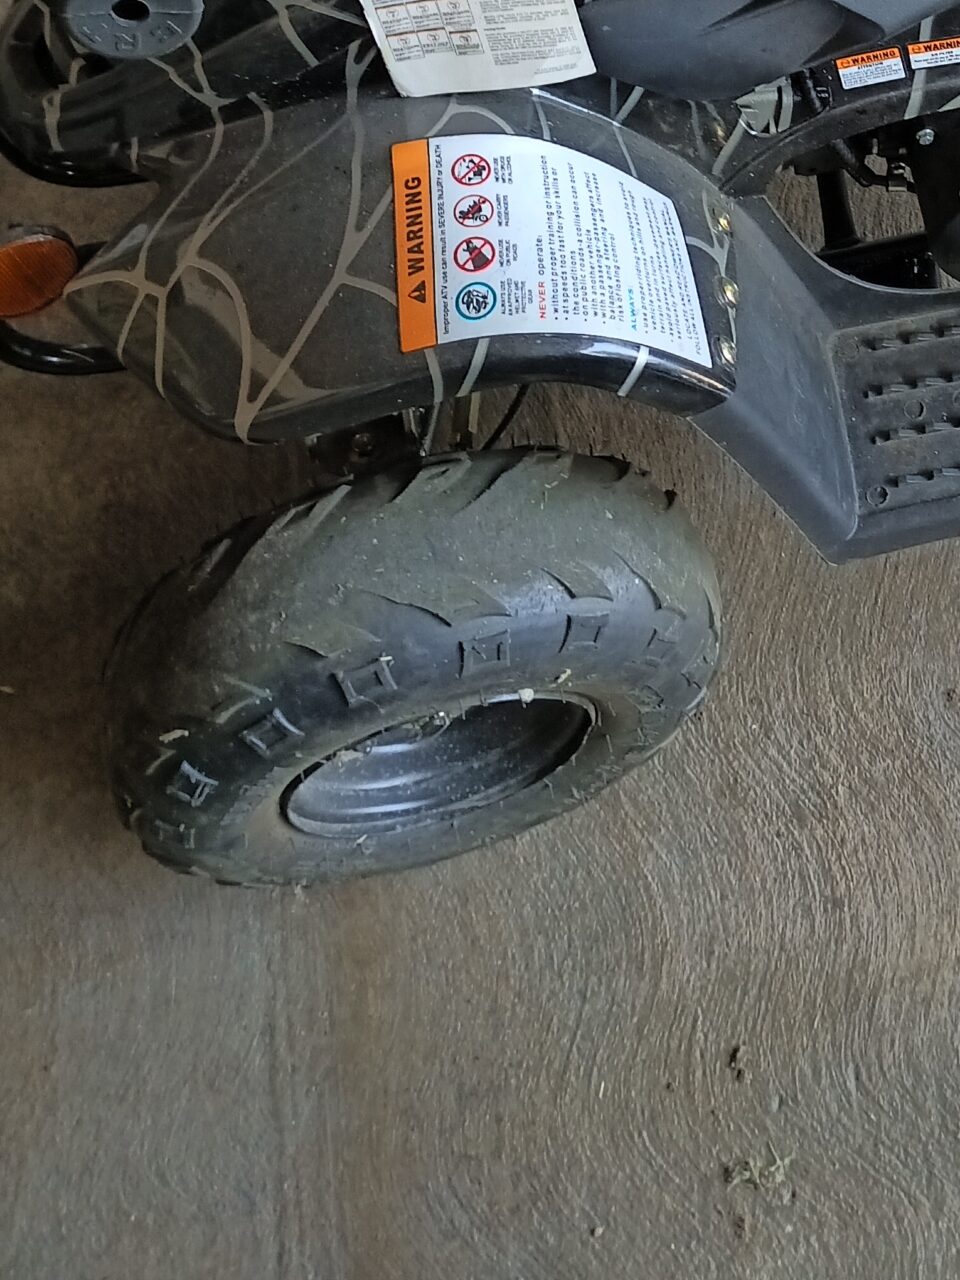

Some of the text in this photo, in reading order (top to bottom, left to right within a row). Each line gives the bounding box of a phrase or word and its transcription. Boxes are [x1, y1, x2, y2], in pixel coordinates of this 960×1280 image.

[850, 50, 896, 65] WARNING
[434, 144, 442, 168] DEATH
[551, 167, 557, 176] or
[567, 162, 575, 184] occur
[436, 178, 444, 200] INJURY
[552, 177, 560, 198] skills
[437, 201, 445, 228] SEVERE
[555, 201, 564, 220] your
[572, 201, 582, 237] collision
[404, 177, 424, 276] WARNING
[540, 155, 559, 313] without proper training or instruction
[591, 173, 616, 320] balance and steering and increase
[608, 232, 618, 263] control
[570, 250, 580, 315] the conditions
[584, 229, 598, 317] with another vehicle
[613, 265, 621, 291] losing
[538, 281, 546, 319] NEVER
[560, 271, 570, 303] speeds
[579, 274, 588, 302] public
[615, 293, 622, 302] of
[562, 305, 569, 314] at
[582, 305, 588, 316] on
